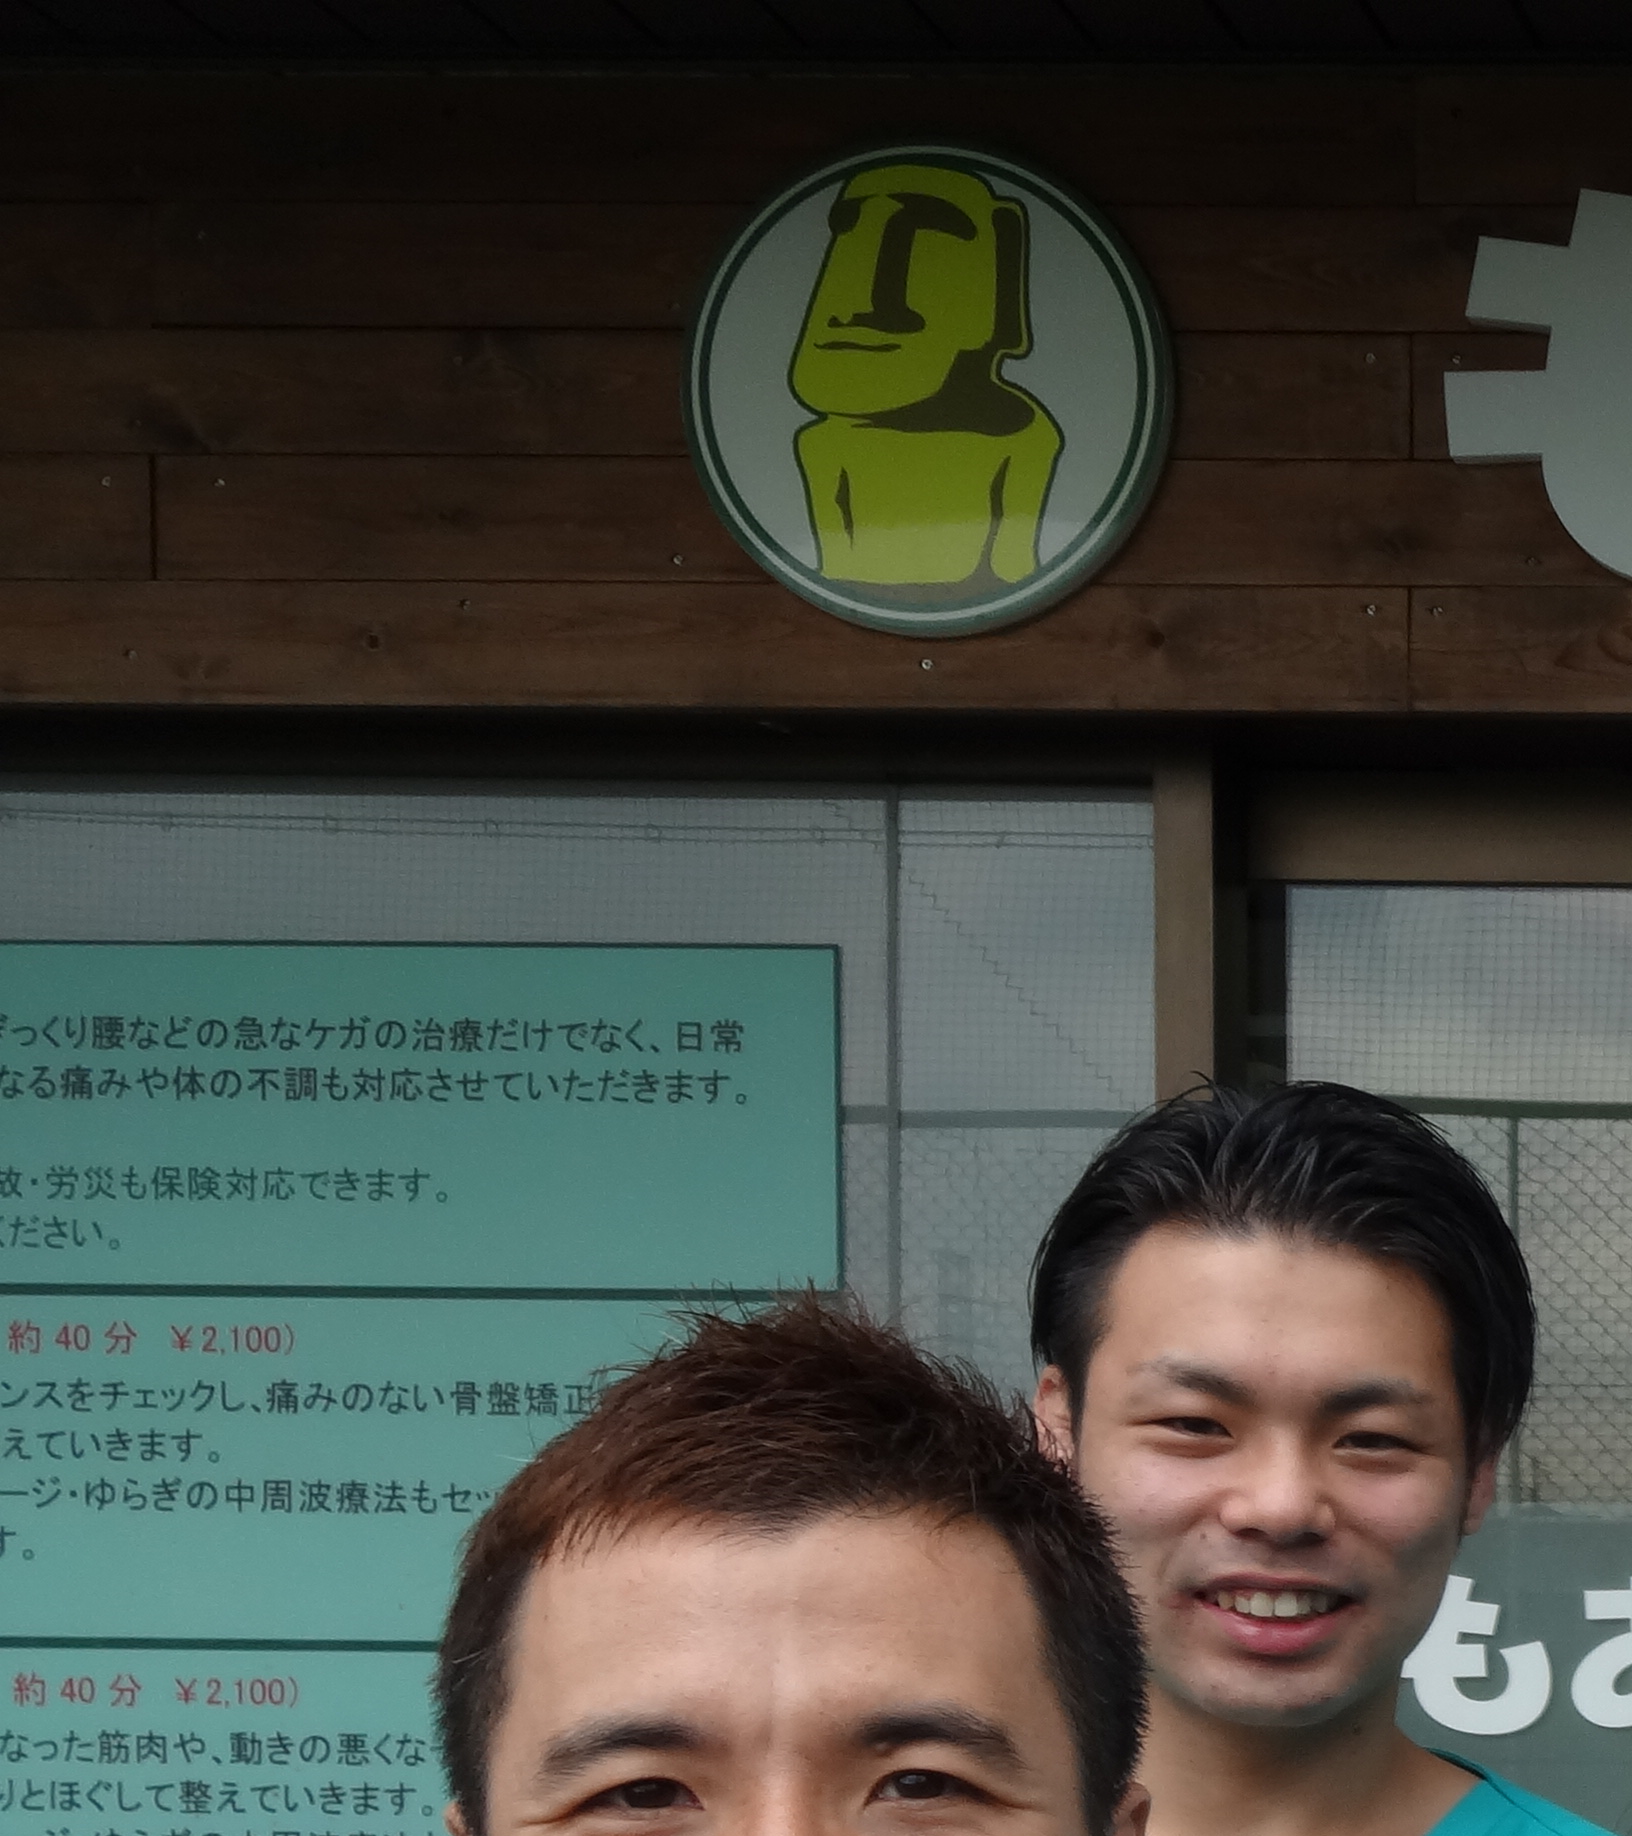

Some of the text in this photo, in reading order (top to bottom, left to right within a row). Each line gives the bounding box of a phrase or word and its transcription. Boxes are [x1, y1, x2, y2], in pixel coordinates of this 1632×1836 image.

[8, 1321, 41, 1354] 約
[55, 1323, 91, 1352] 40
[104, 1321, 137, 1354] 分
[2, 1427, 222, 1464] えていきます。
[13, 1674, 47, 1708] 約
[60, 1678, 97, 1704] 40
[109, 1674, 142, 1708] 分
[0, 1731, 443, 1768] なった筋肉や、動きの悪くな
